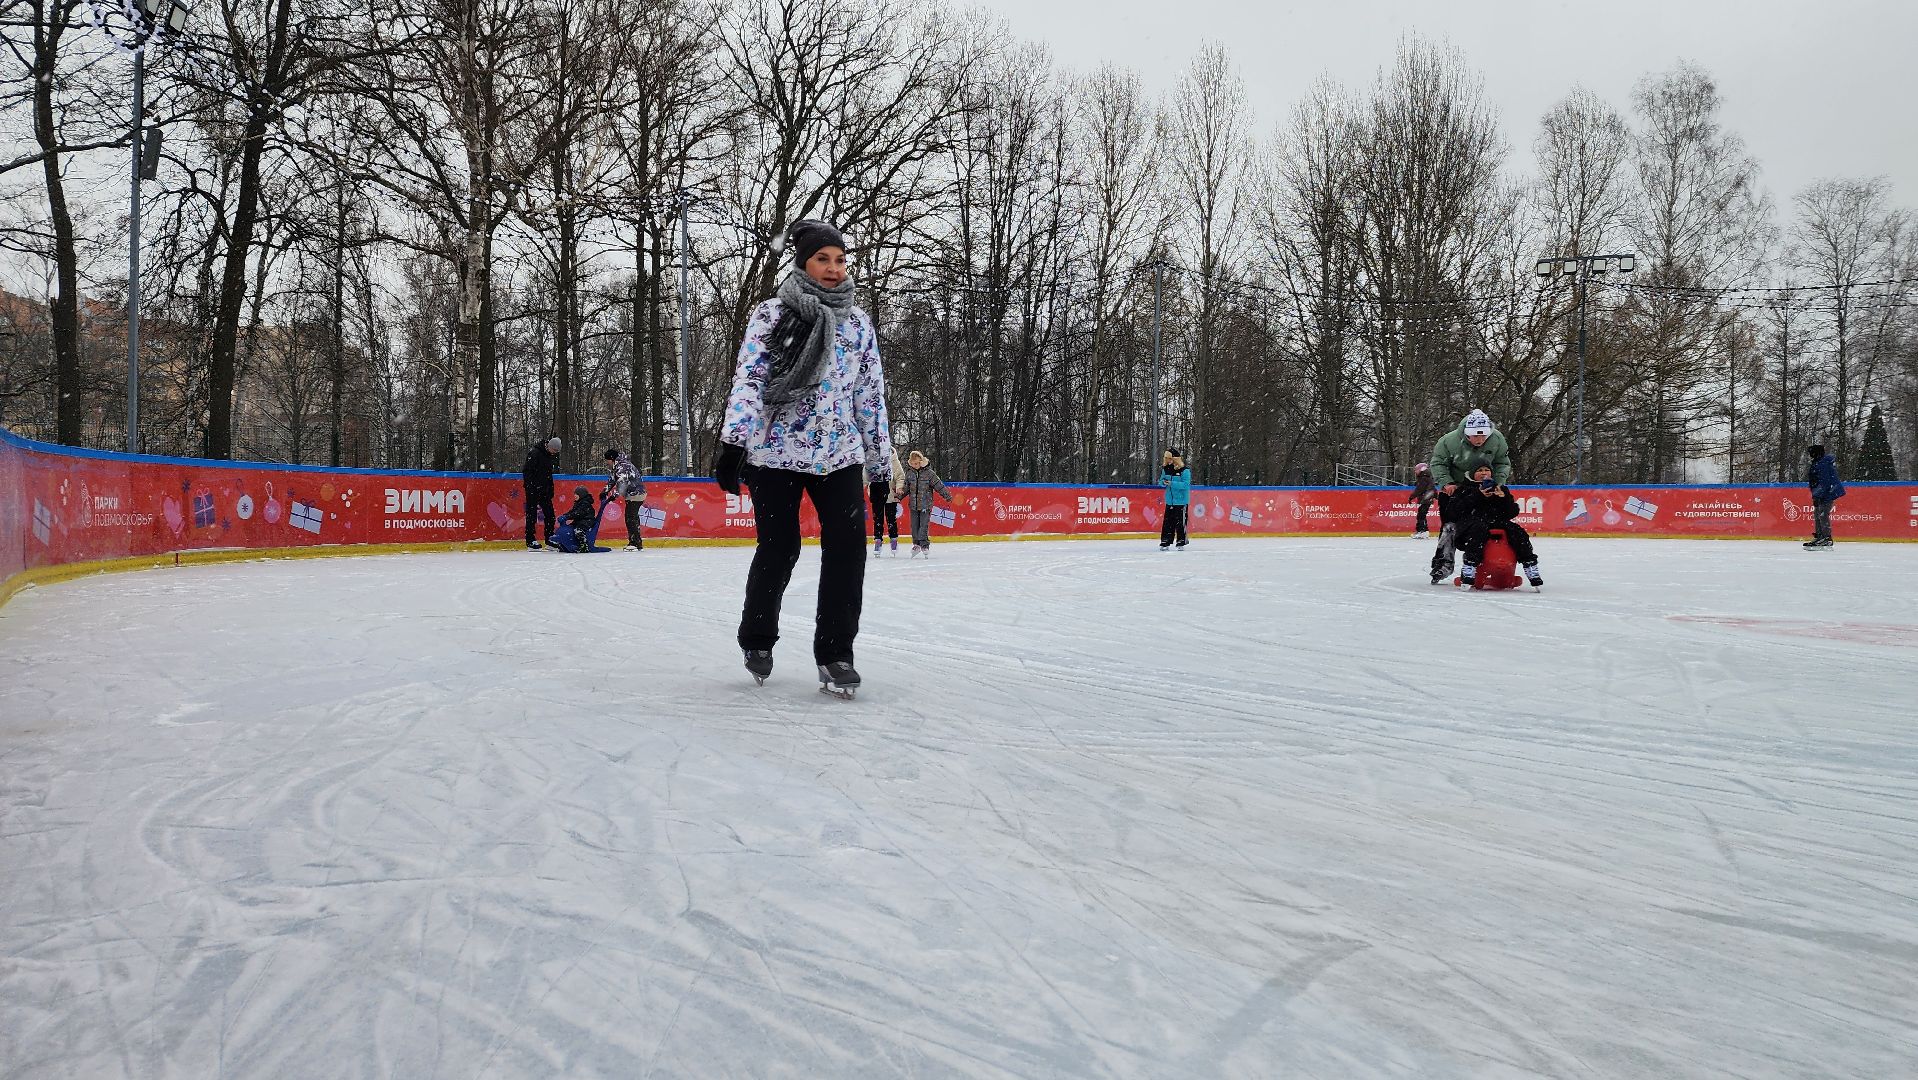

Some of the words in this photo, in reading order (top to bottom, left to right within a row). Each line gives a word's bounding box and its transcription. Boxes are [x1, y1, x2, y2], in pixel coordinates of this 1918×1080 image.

[94, 496, 118, 510] ПАРКИ
[384, 488, 465, 513] ЗИМА
[725, 493, 755, 515] ЗИ
[1077, 496, 1130, 514] ЗИМА
[1692, 500, 1742, 509] КАТАЙТЕСЬ
[1008, 505, 1032, 513] ПАРКИ
[94, 513, 153, 526] ПОДМОСКОВЬЯ
[384, 519, 391, 529] В
[393, 518, 465, 530] ПОДМОСКОВЬЕ
[725, 518, 732, 527] В
[1084, 516, 1130, 525] ПОДМОСКОВЬЕ
